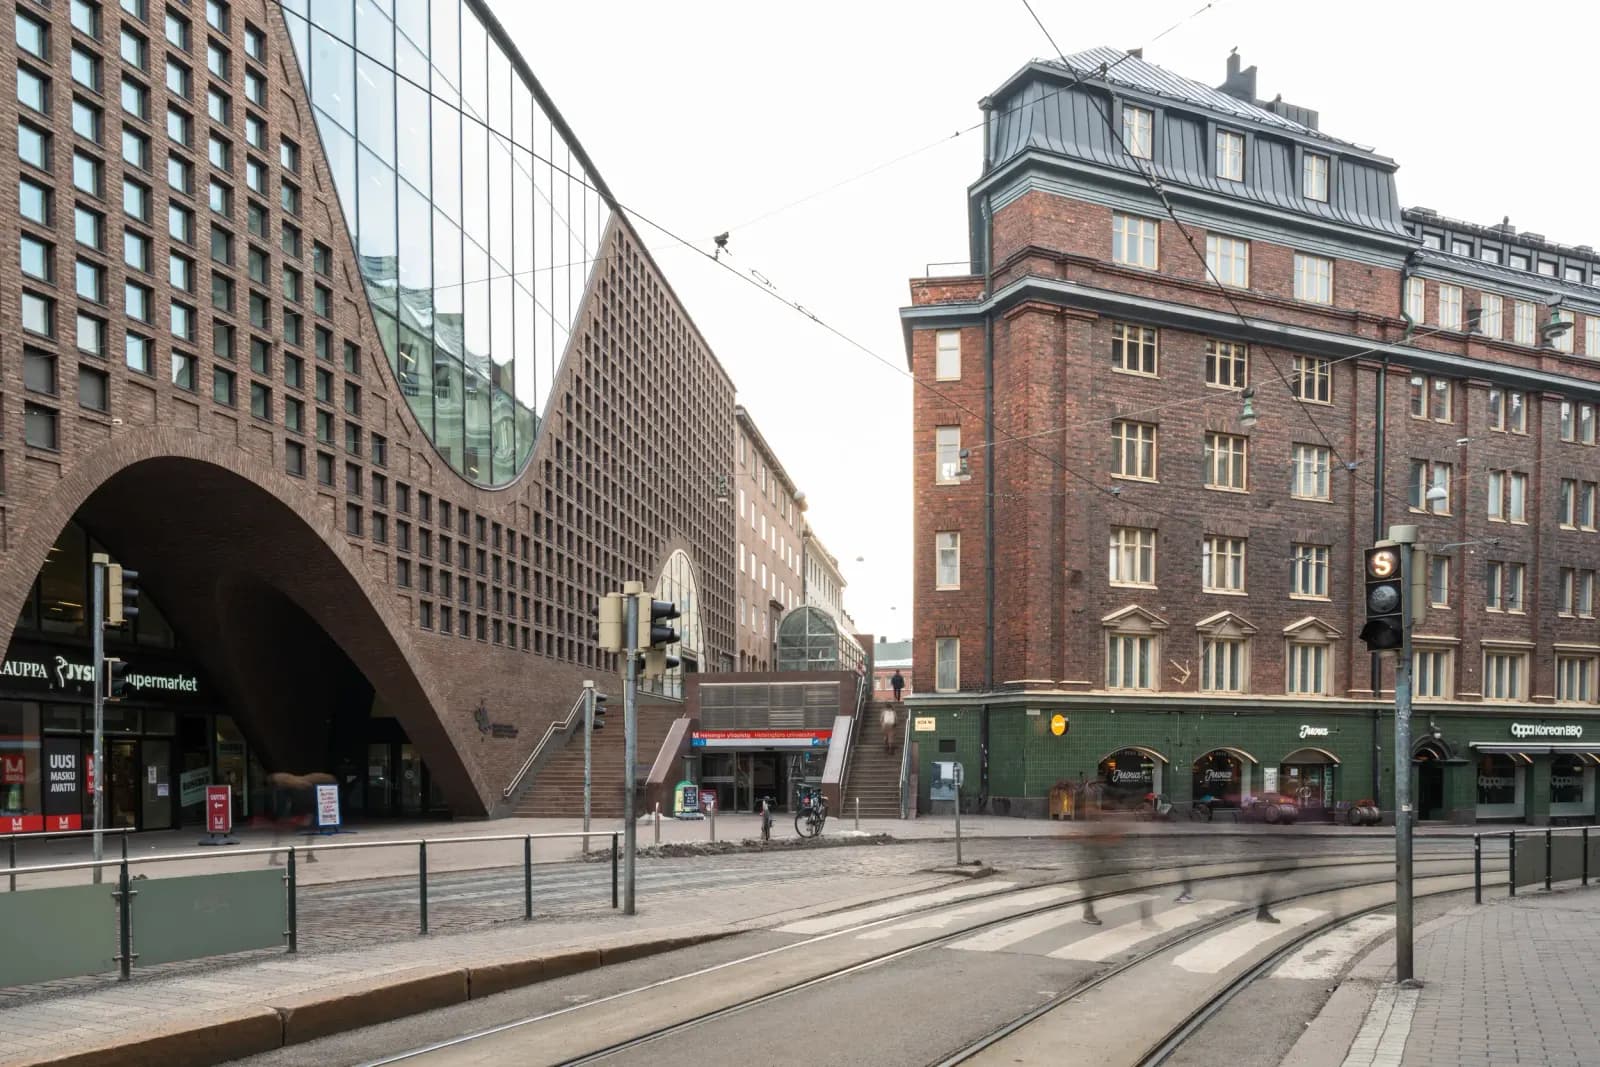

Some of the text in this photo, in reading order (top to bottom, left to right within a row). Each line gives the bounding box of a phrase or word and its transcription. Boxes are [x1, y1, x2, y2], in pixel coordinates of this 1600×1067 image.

[1374, 551, 1392, 575] S
[0, 660, 48, 679] AUPPA
[66, 663, 96, 682] JYS
[125, 673, 197, 692] upermarket
[1511, 723, 1582, 738] Oppa Korean BBQ
[50, 754, 75, 769] UUSI
[50, 771, 75, 781] MASKU
[50, 783, 75, 793] AVATTU
